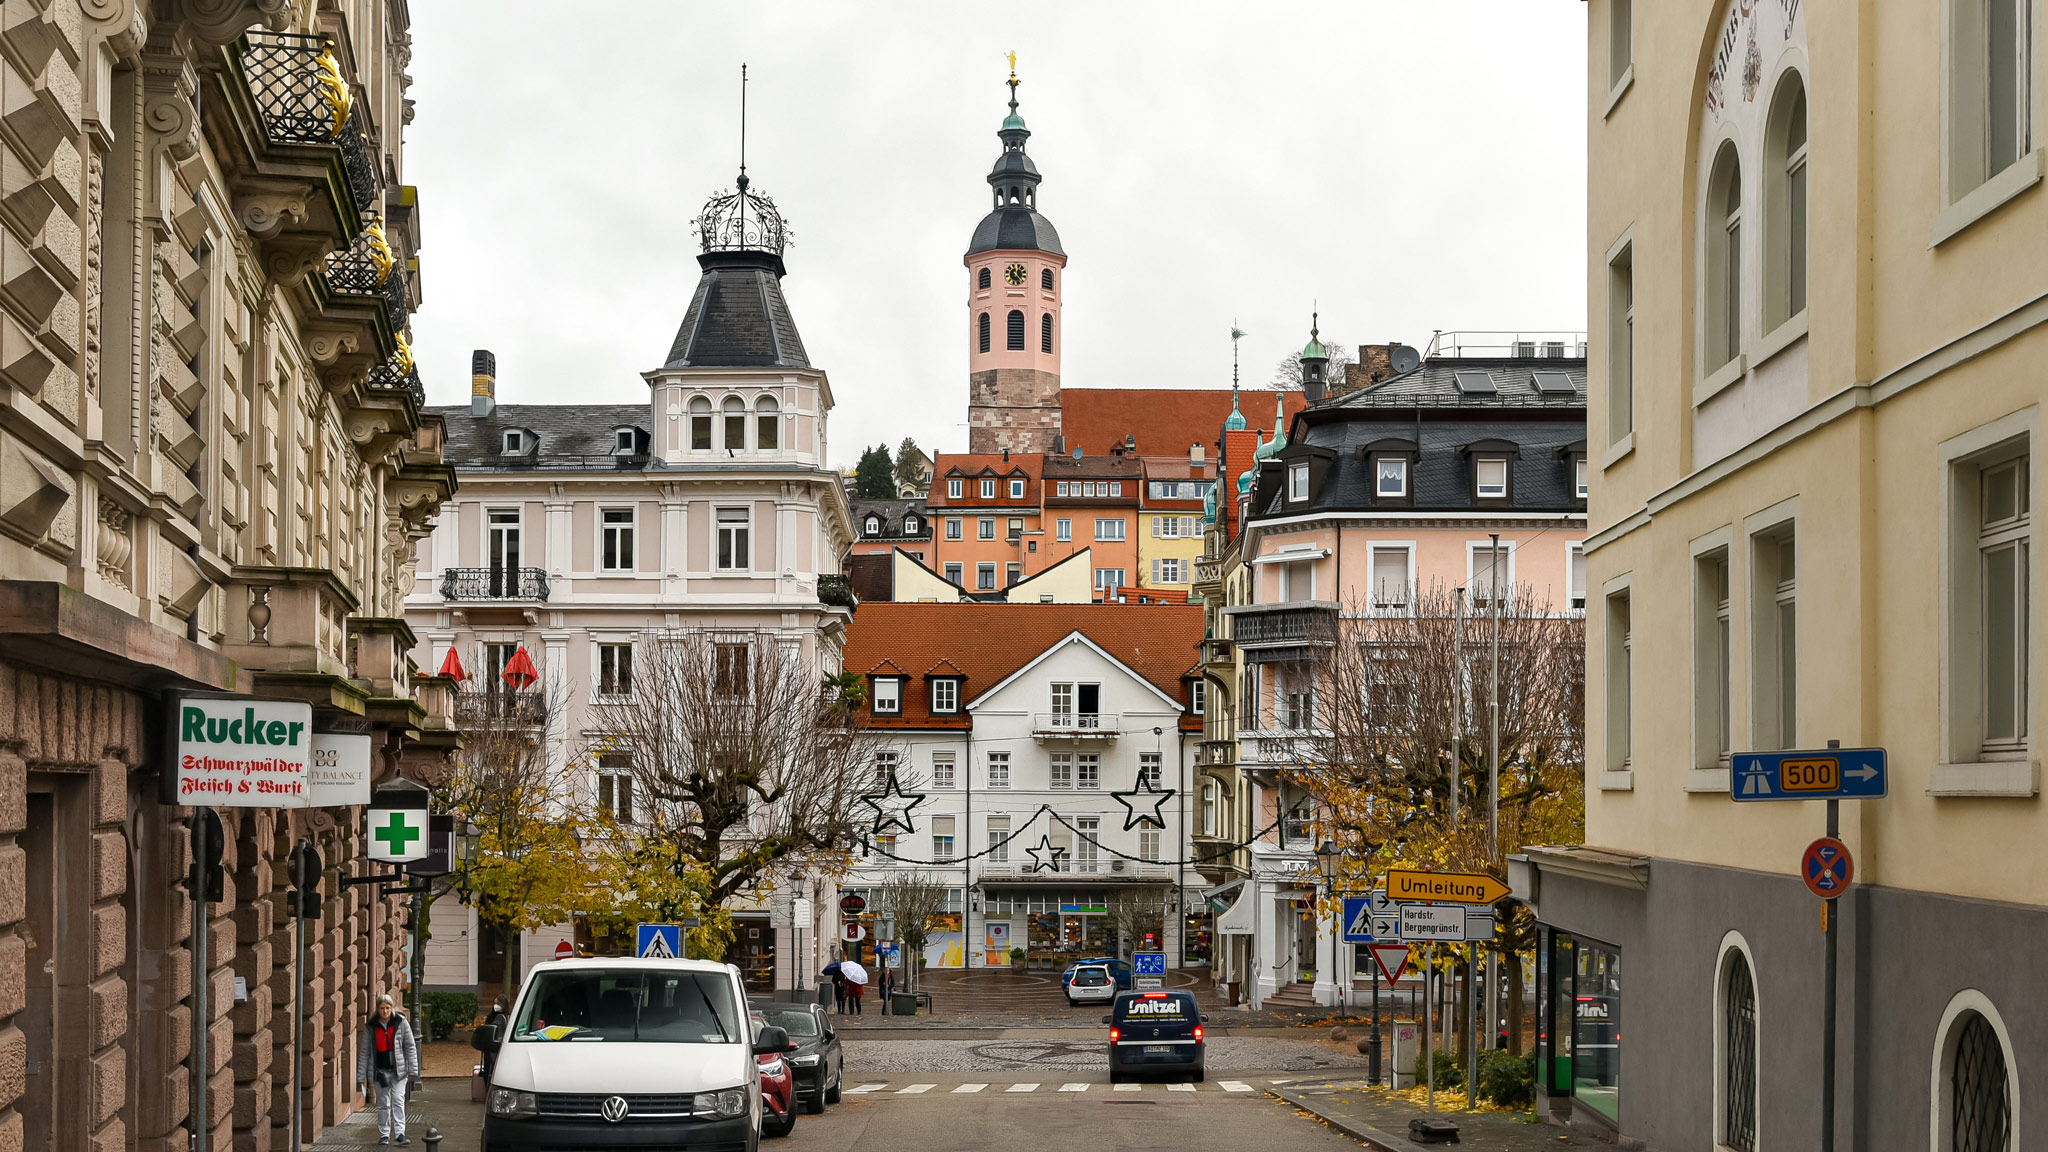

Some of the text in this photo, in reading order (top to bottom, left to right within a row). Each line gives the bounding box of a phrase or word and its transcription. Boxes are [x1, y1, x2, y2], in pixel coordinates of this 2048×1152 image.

[182, 706, 304, 746] Rucker
[181, 754, 303, 776] Schwarzwälder
[323, 771, 364, 780] BALANCE
[1788, 764, 1831, 786] 500
[237, 779, 253, 794] &
[1400, 878, 1486, 900] Umleitung
[1404, 909, 1435, 920] Hardstr.
[1404, 922, 1461, 935] Bergengrünstr.
[1128, 999, 1181, 1014] Smitzel
